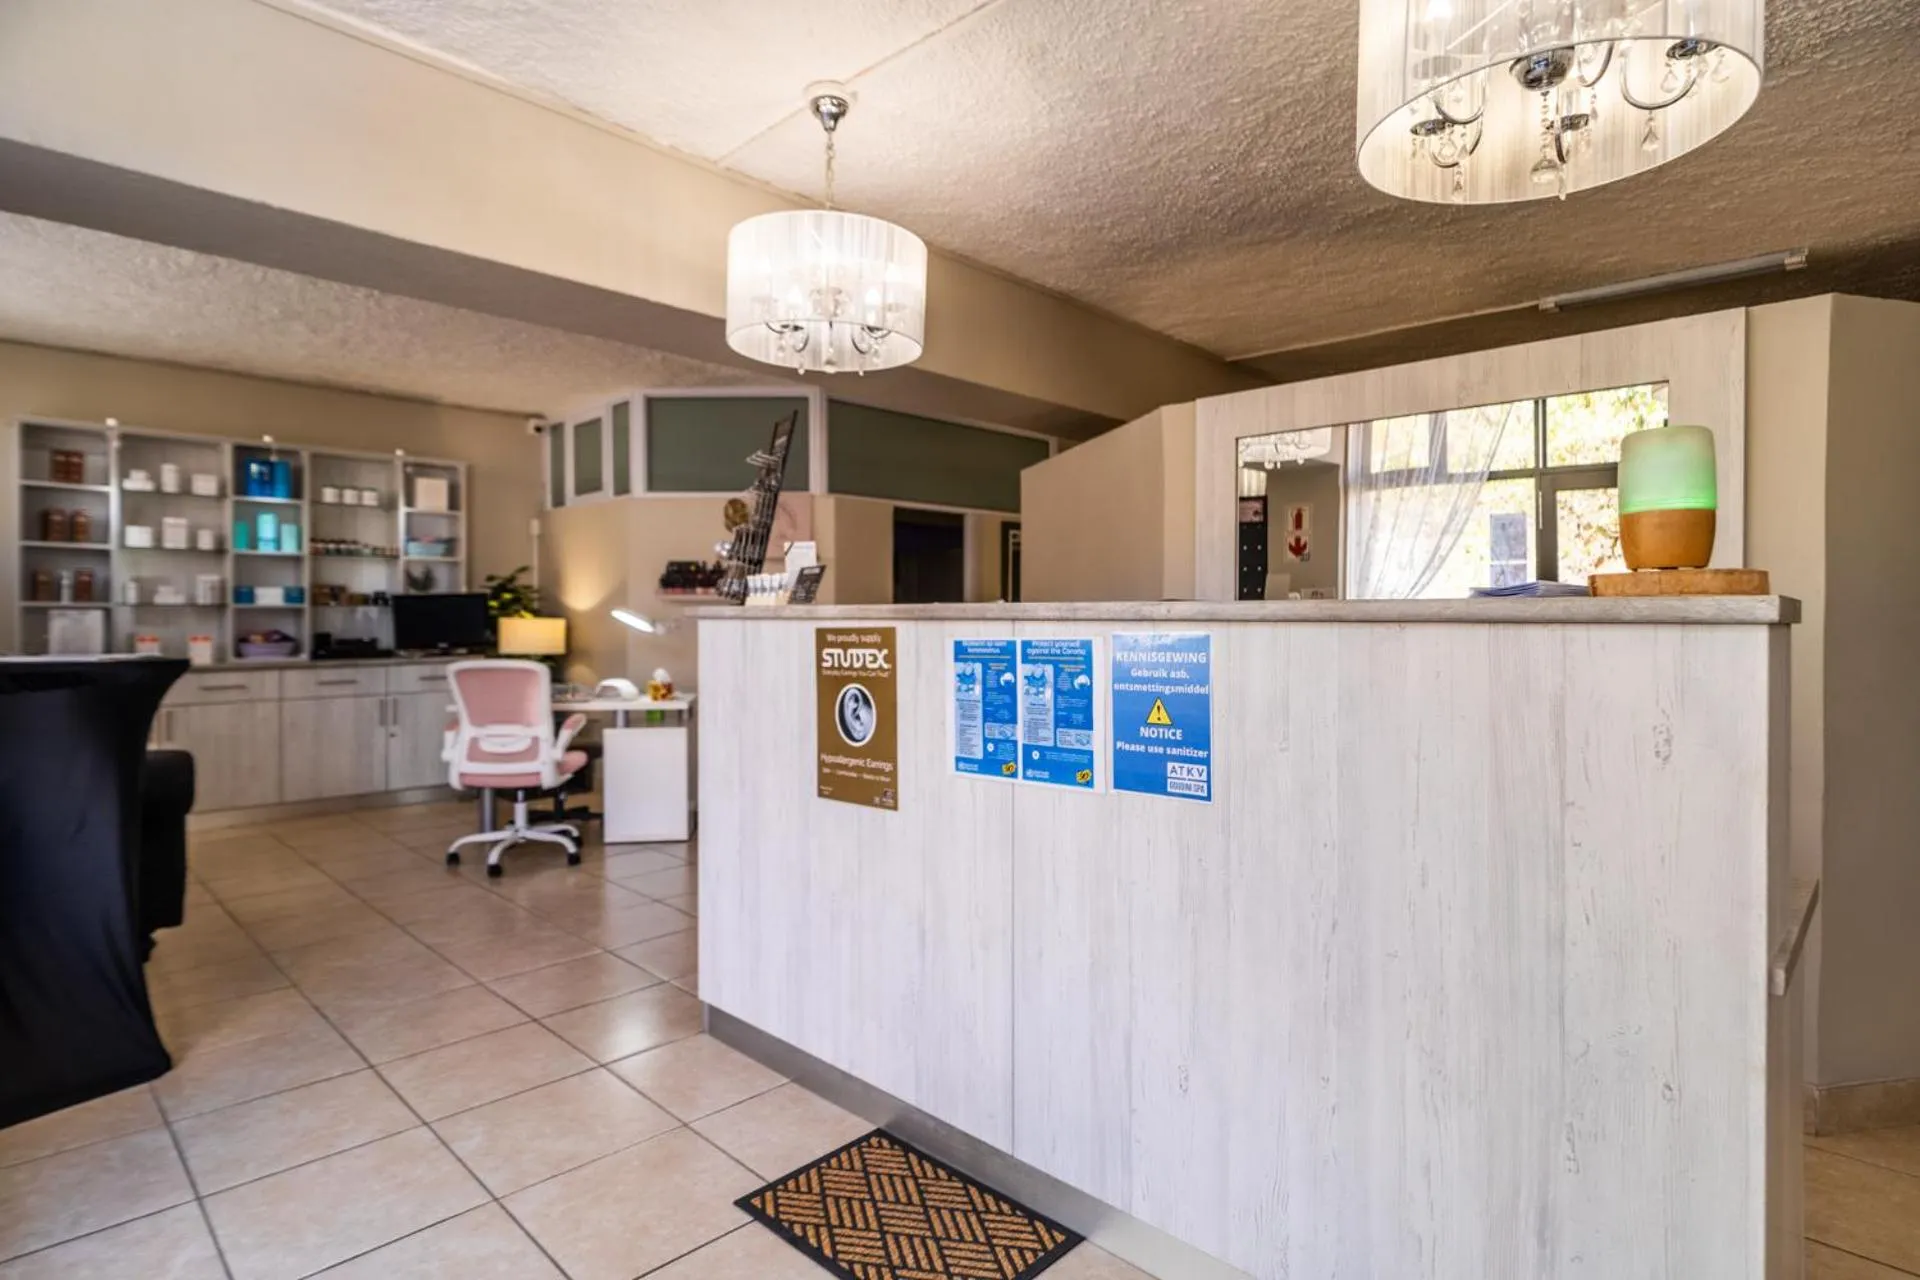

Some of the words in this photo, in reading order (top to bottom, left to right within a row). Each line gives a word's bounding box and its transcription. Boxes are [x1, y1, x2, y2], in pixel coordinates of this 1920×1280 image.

[837, 633, 859, 644] proudly
[860, 633, 882, 644] supply
[821, 648, 889, 669] STUDEX
[1116, 651, 1207, 664] KENNISGEWING
[1130, 668, 1168, 678] Gebruik
[1169, 669, 1190, 679] asb.
[1113, 683, 1208, 695] entsmettingsmiddel
[1139, 726, 1183, 740] NOTICE
[1116, 741, 1146, 753] Please
[1147, 745, 1164, 754] use
[1166, 746, 1208, 758] sanitizer
[866, 758, 894, 773] Earrings
[1170, 765, 1205, 778] ATKV
